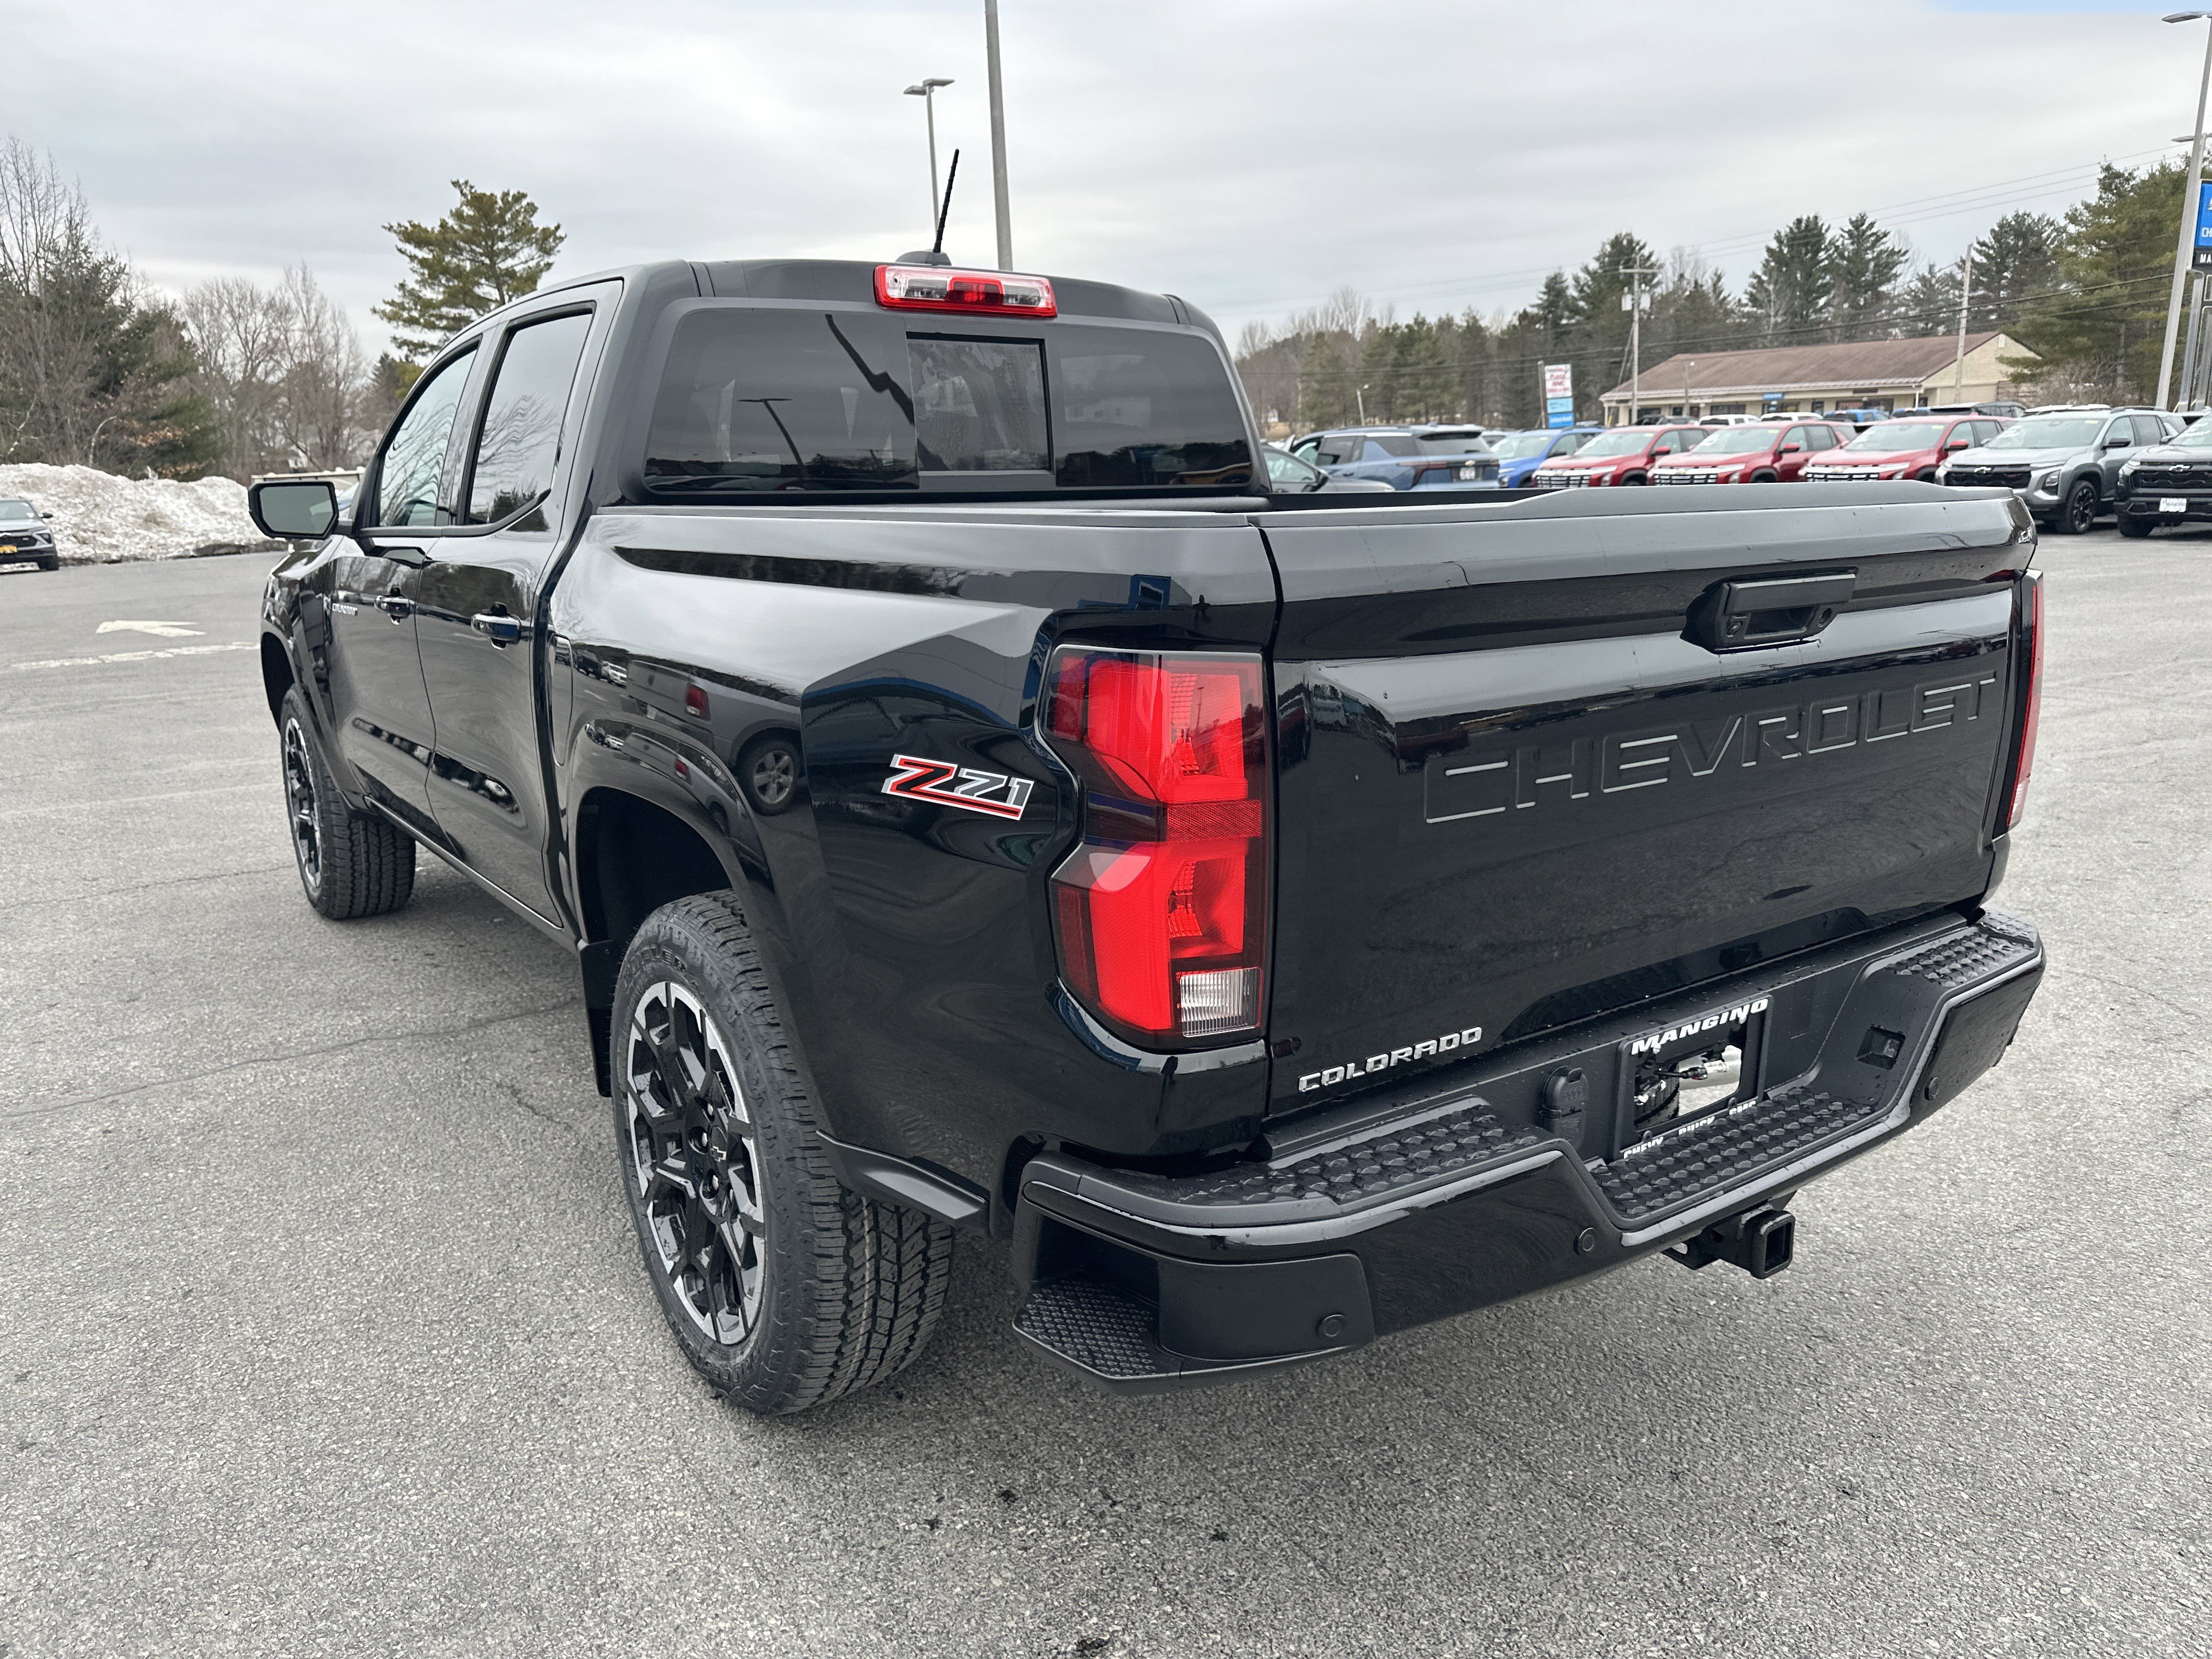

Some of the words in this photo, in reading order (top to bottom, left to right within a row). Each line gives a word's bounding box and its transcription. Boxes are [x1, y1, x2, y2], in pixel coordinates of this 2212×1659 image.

[1424, 670, 1996, 823] CHEVROLET
[881, 753, 1034, 821] Z71
[1298, 1026, 1482, 1092] COLORADO
[1631, 998, 1768, 1054] MANGINO
